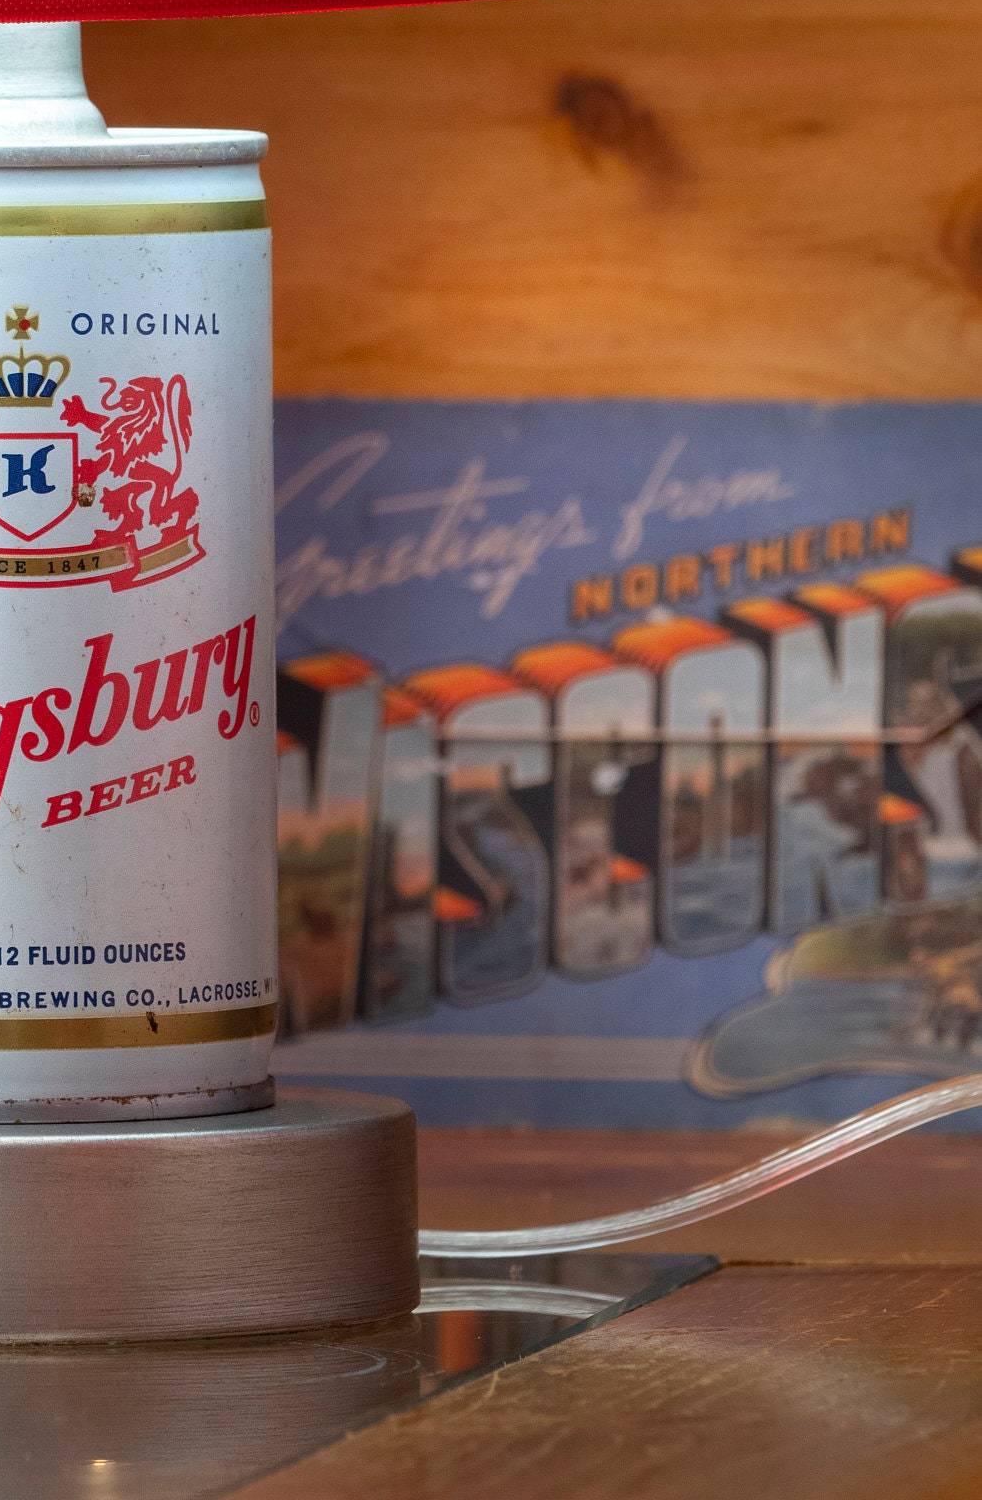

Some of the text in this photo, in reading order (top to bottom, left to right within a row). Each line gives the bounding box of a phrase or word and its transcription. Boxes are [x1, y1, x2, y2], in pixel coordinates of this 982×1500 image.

[70, 311, 220, 336] ORIGINAL
[612, 434, 800, 559] from
[47, 555, 101, 575] 1847
[569, 508, 912, 622] NORTHERN
[40, 754, 198, 829] BEER
[27, 945, 96, 966] FLUID
[103, 941, 187, 964] OUNCES
[125, 988, 171, 1009] CO.,
[178, 979, 261, 1004] LACROSSE,
